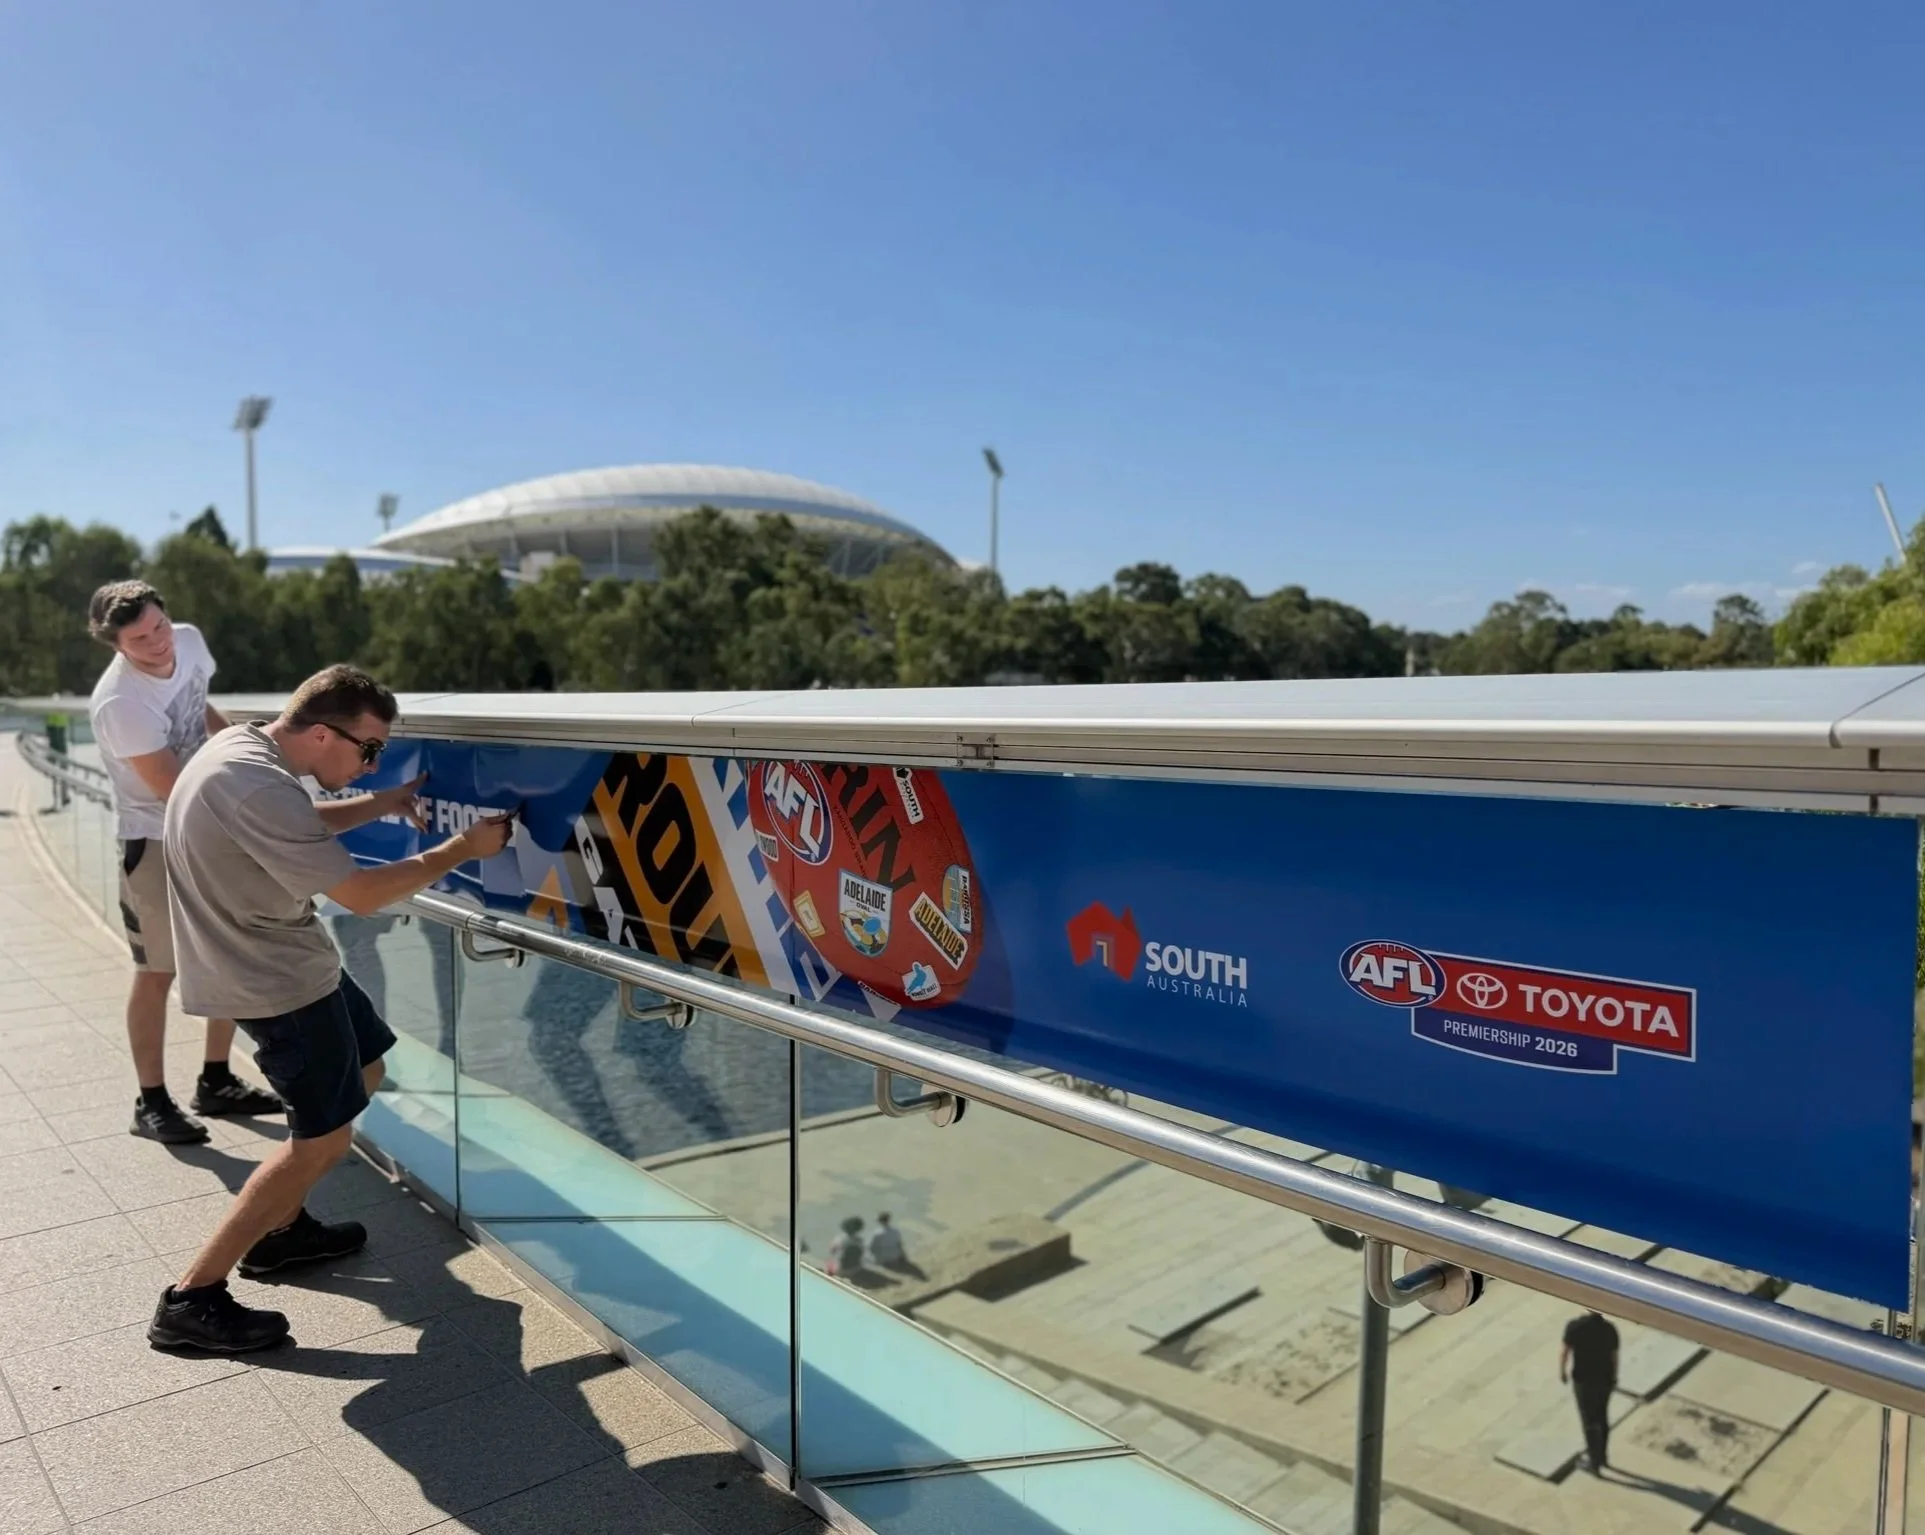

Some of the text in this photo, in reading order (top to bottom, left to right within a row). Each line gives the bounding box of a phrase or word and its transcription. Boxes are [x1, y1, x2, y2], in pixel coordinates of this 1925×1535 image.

[435, 798, 516, 848] FOO
[764, 761, 820, 858] AFL
[901, 779, 920, 818] SOUTH
[574, 815, 639, 951] GA
[603, 753, 744, 978] ROU
[844, 878, 887, 912] ADELAIDE
[856, 902, 872, 913] OVAL
[914, 899, 964, 963] ADELAIDE
[1145, 941, 1248, 990] SOUTH
[1350, 952, 1436, 997] AFL
[1146, 974, 1248, 1008] AUSTRALIA
[1518, 983, 1679, 1038] TOYOTA
[1443, 1019, 1578, 1058] PREMIERSHIP 2026
